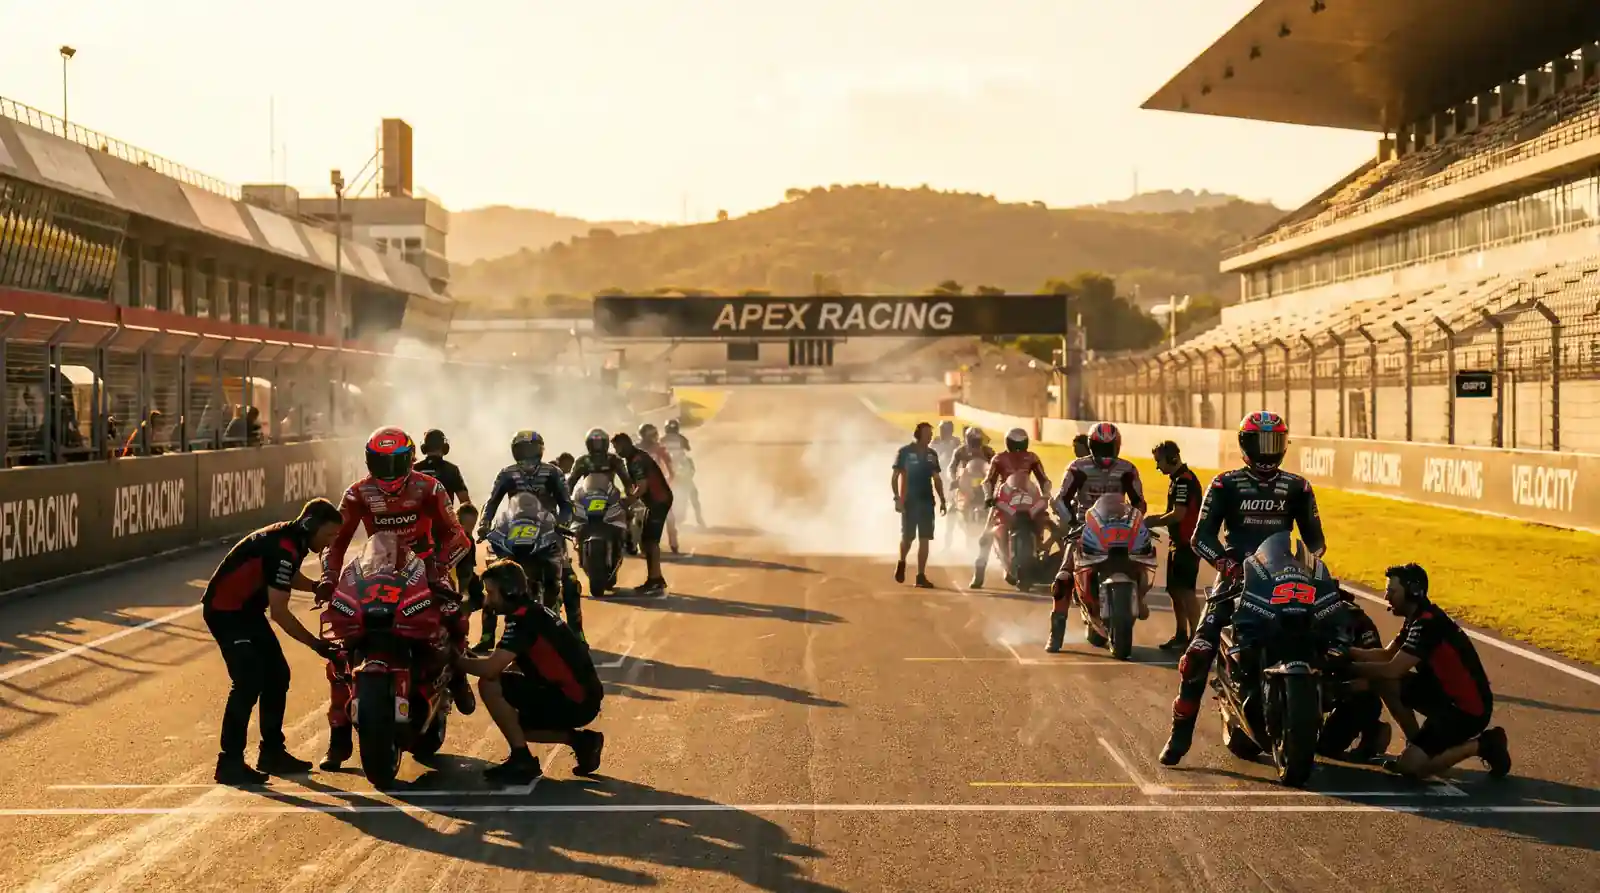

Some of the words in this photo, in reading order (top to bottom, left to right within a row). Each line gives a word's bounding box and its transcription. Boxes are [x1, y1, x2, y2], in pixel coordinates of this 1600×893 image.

[712, 302, 811, 330] APEX
[817, 302, 954, 330] RACING
[210, 472, 233, 518] APEX
[235, 468, 265, 512] RACING
[1422, 456, 1447, 493] APEX
[1447, 457, 1483, 499] RACING
[1512, 464, 1578, 512] VELOCITY
[113, 484, 143, 538] APEX
[146, 478, 184, 531] RACING
[374, 514, 417, 525] Lenovo
[1240, 499, 1286, 511] MOTO-X
[0, 500, 23, 562] EX
[27, 492, 78, 556] RACING
[402, 599, 432, 616] Lenovo
